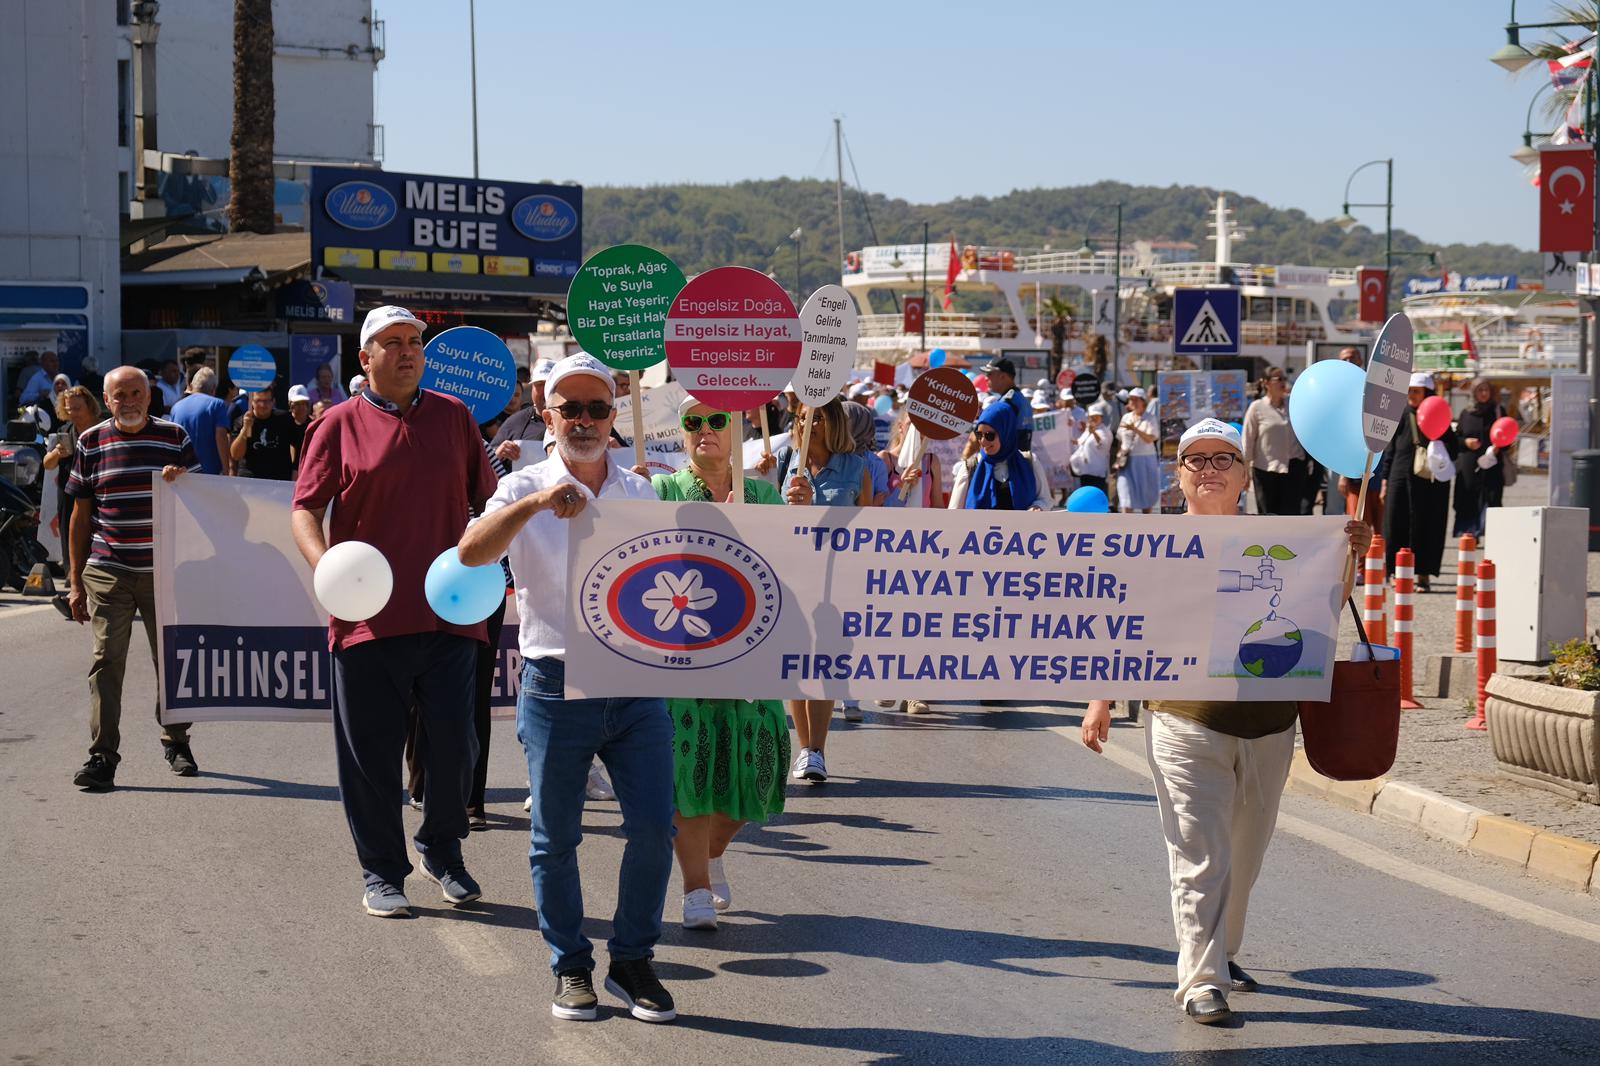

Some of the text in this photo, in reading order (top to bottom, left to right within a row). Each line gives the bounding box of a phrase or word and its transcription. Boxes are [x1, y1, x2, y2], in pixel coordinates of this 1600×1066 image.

[413, 217, 497, 250] BÜFE
[585, 264, 635, 278] "Toprak,
[638, 262, 668, 274] Ağaç
[602, 279, 653, 293] Ve Suyla
[588, 295, 669, 312] Hayat Yeşerir;
[679, 299, 786, 315] Engelsiz Doğa,
[577, 312, 666, 329] Biz De Eşit Hak
[815, 314, 842, 328] Gelirle
[603, 328, 661, 343] Fırsatlarla
[675, 323, 791, 339] Engelsiz Hayat,
[803, 331, 848, 347] Tanımlama,
[436, 342, 506, 371] Suyu Koru,
[603, 345, 663, 361] Yeşeririz."
[690, 349, 775, 365] Engelsiz Bir
[810, 350, 835, 364] Bireyi
[1380, 339, 1410, 363] Bir Damla
[424, 356, 510, 390] Hayatını Koru,
[697, 373, 771, 387] Gelecek...
[808, 368, 831, 379] Hakla
[1384, 368, 1395, 385] Su,
[434, 377, 490, 401] Haklarını
[928, 393, 956, 413] Değil,
[1380, 393, 1391, 410] Bir
[909, 402, 939, 419] Bireyi
[1370, 418, 1389, 437] Nefes
[618, 532, 716, 560] ÖZÜRLÜLER
[793, 525, 1205, 560] "TOPRAK, AĞAÇ VE SUYLA
[865, 566, 1127, 604] HAYAT YEŞERİR;
[586, 564, 614, 640] ZİHİNSEL
[725, 544, 774, 646] FEDERASYONU
[842, 604, 1145, 642] BİZ DE EŞİT HAK VE
[175, 635, 327, 700] ZİHİNSEL
[663, 655, 692, 666] 1985
[780, 648, 1198, 685] FIRSATLARLA YEŞERİRİZ."
